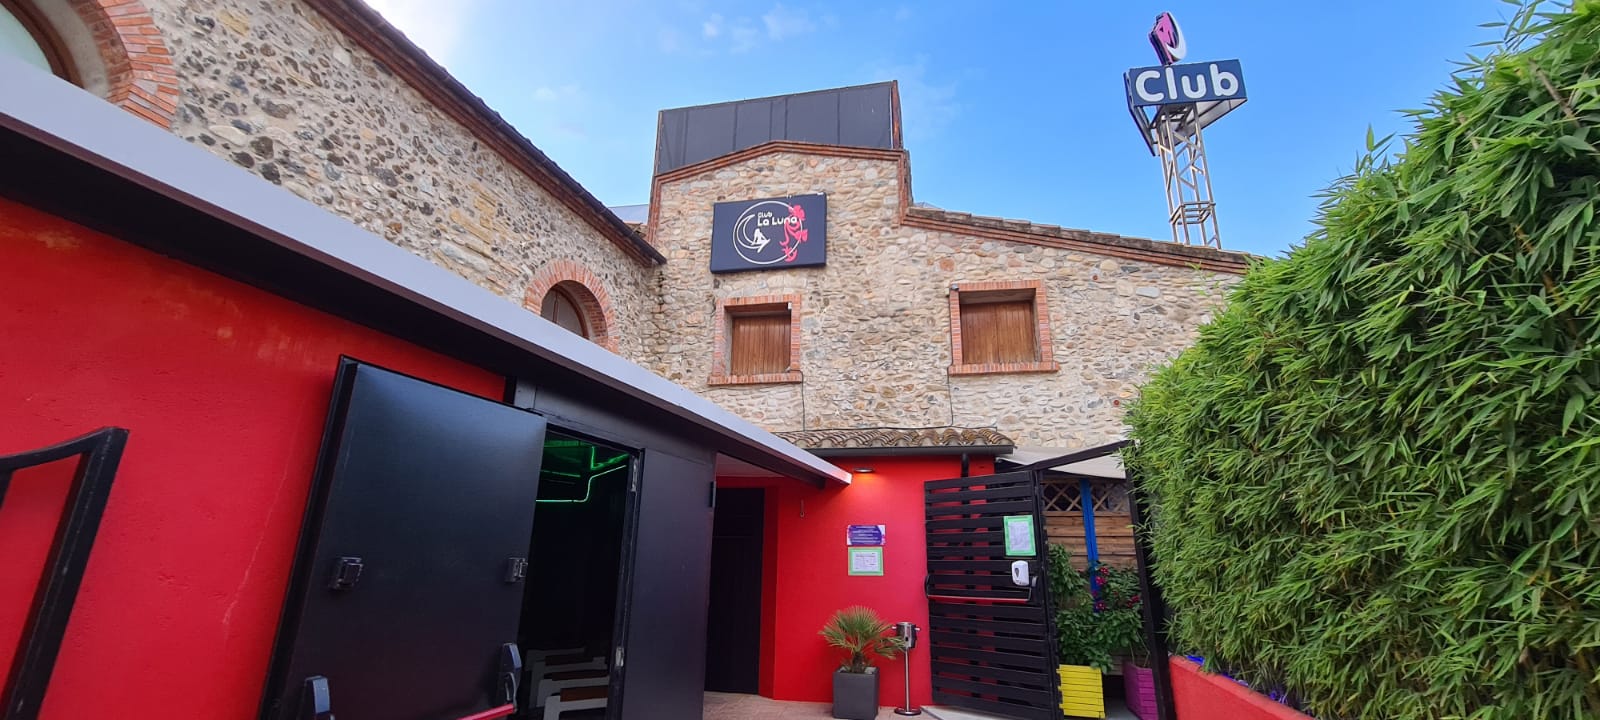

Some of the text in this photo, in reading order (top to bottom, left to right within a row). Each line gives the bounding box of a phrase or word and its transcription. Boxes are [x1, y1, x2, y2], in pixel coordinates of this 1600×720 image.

[1135, 63, 1239, 102] Club
[757, 216, 798, 227] La Luna
